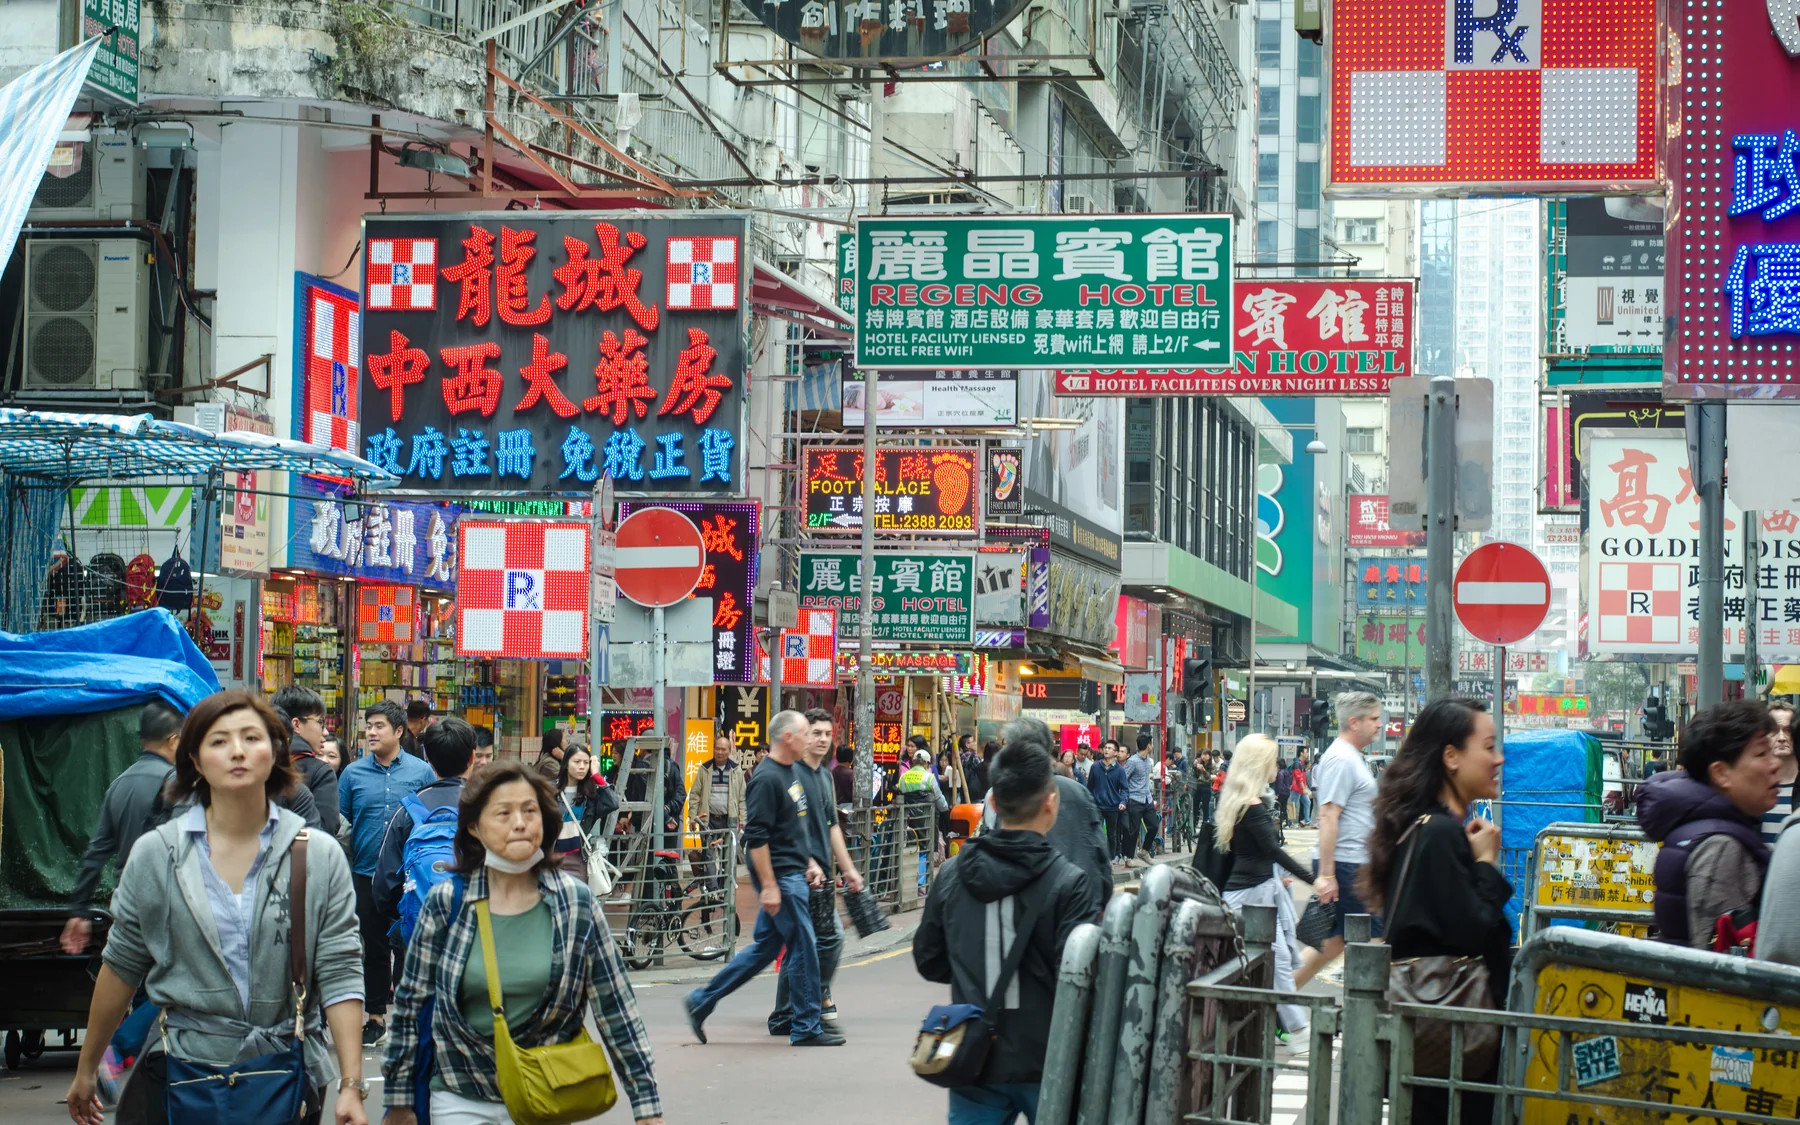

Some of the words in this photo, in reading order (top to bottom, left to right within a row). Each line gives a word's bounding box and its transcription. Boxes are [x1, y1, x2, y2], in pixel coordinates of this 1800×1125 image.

[867, 227, 1223, 282] 麗晶賓館
[441, 222, 660, 331] 龍城
[870, 284, 1043, 307] REGENG
[1080, 283, 1217, 307] HOTEL
[865, 309, 944, 329] 持牌賓館
[950, 309, 1029, 329] 酒店設備
[1035, 309, 1114, 329] 豪華套房
[1120, 309, 1220, 329] 歡迎自由行
[1238, 287, 1370, 350] 賓館
[1617, 305, 1659, 315] Unlimited
[865, 333, 908, 344] HOTEL
[911, 333, 968, 344] FACILITY
[972, 333, 1026, 344] LIENSED
[1132, 333, 1189, 355] 請上2/F
[865, 345, 908, 356] HOTEL
[911, 345, 941, 356] FREE
[944, 345, 973, 356] WIFI
[1269, 351, 1405, 374] HOTEL
[367, 328, 733, 426] 中西大藥房
[1095, 379, 1147, 391] HOTEL
[1151, 379, 1237, 391] FACILITEIS
[1240, 379, 1282, 391] OVER
[1285, 379, 1336, 391] NIGHT
[1339, 379, 1378, 391] LESS
[961, 385, 997, 394] Massage
[366, 426, 536, 480] 政府註冊
[558, 425, 735, 483] 免稅正貨
[810, 480, 856, 494] FOOT
[860, 480, 931, 495] ALACE
[809, 513, 832, 527] 2/F
[939, 514, 972, 528] 2093
[901, 596, 968, 613] HOTEL
[896, 655, 957, 667] MASSAGE
